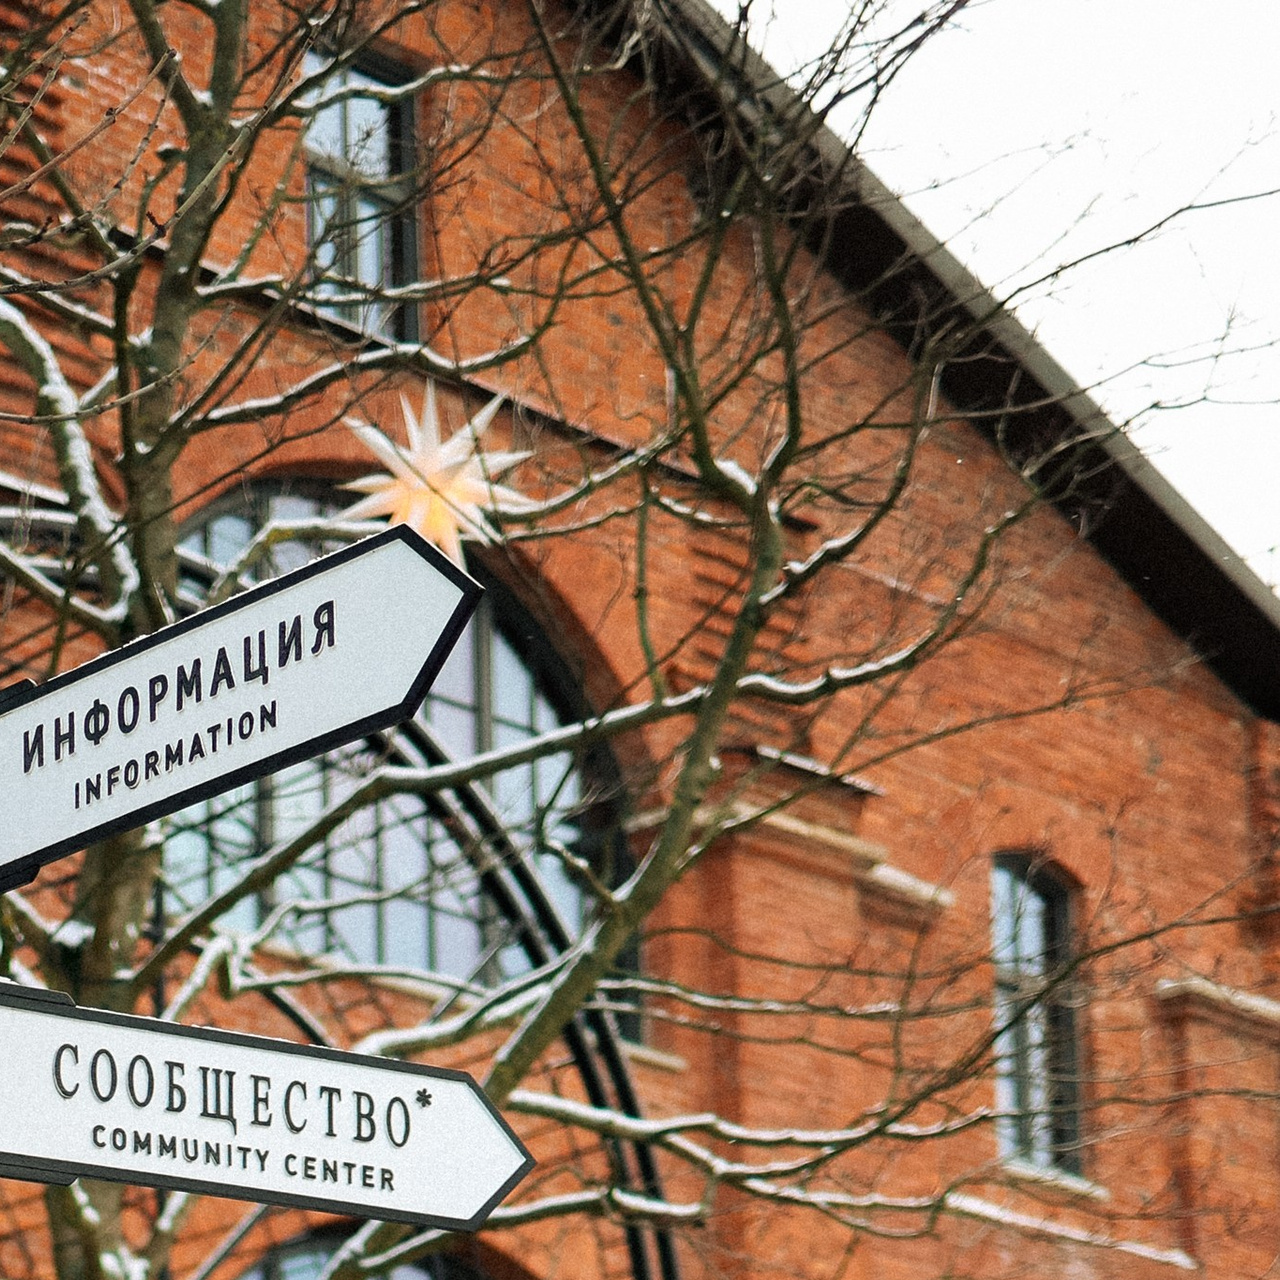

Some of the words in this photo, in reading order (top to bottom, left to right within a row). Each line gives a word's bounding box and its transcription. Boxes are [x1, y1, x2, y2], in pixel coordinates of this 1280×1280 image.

[22, 599, 337, 775] ИНФОРМАЦИЯ
[73, 699, 279, 811] INFORMATION
[91, 1124, 271, 1174] COMMUNITY
[283, 1153, 396, 1192] CENTER
